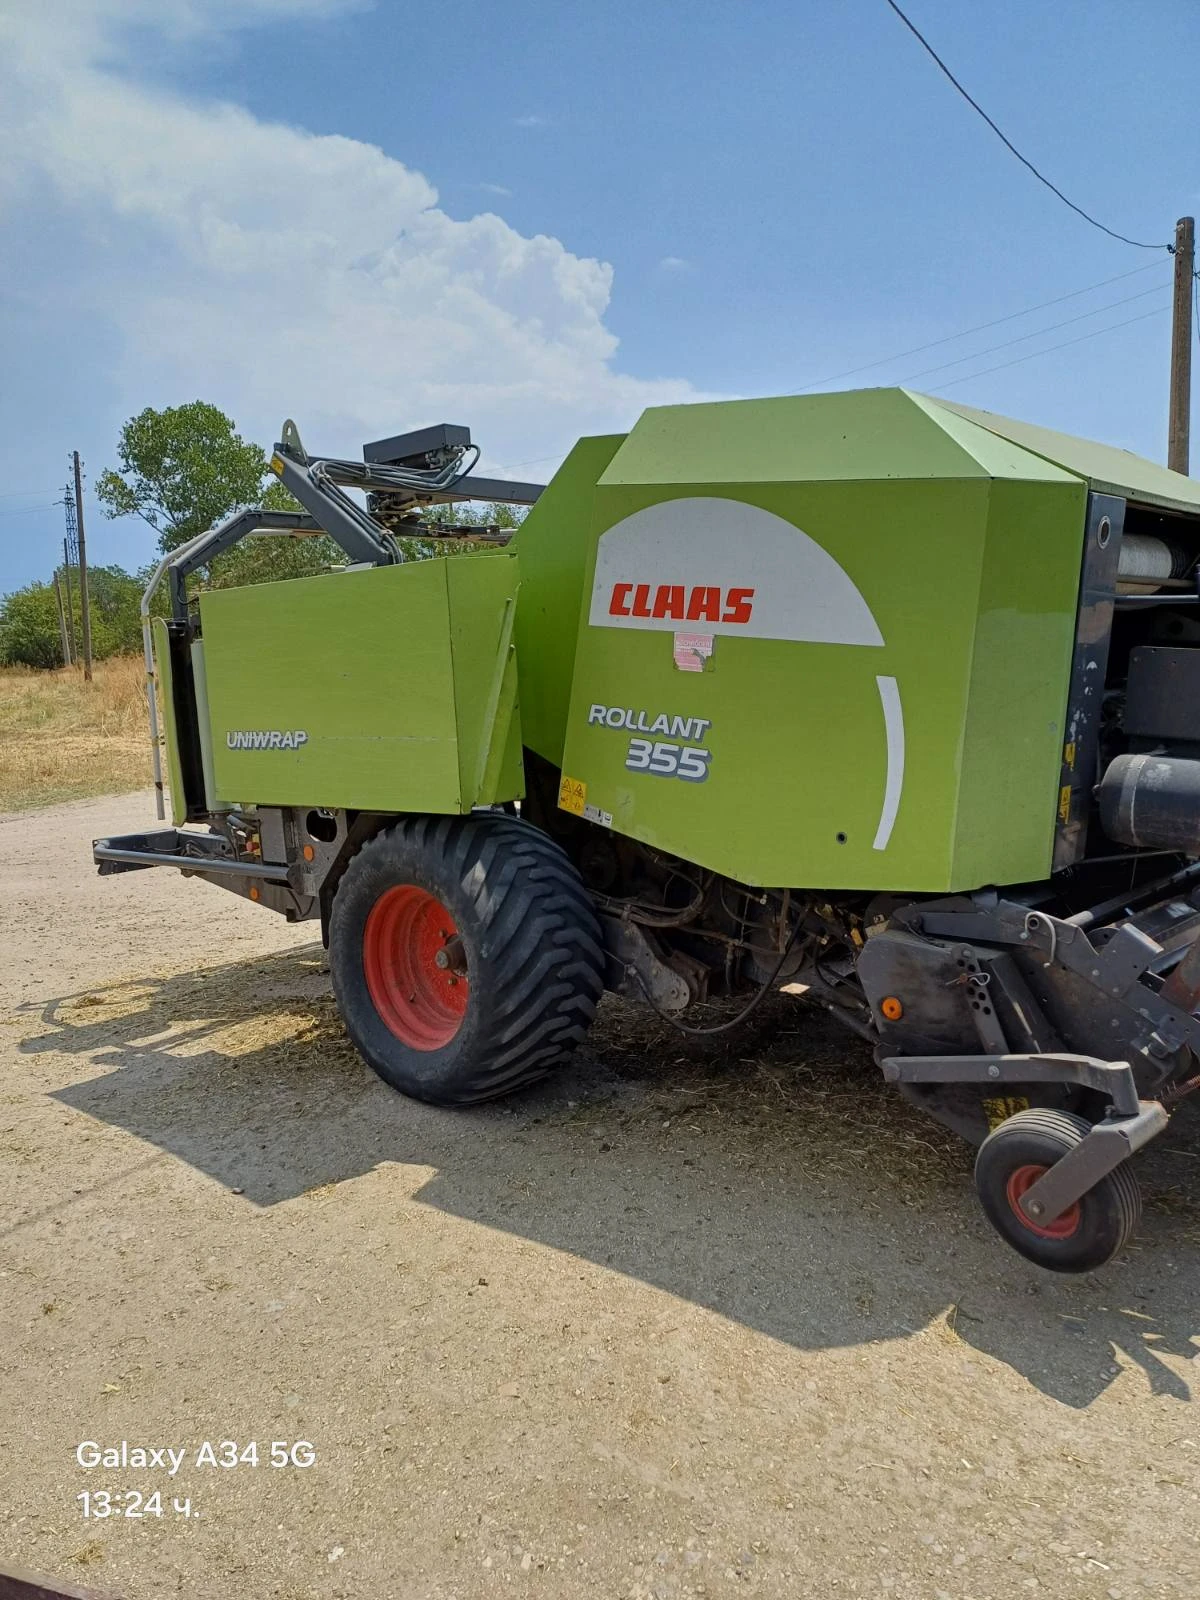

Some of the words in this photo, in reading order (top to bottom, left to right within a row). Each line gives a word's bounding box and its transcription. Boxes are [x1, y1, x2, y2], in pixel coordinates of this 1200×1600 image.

[609, 583, 755, 623] CLAAS
[226, 730, 308, 749] UNIWRAP
[588, 704, 710, 740] ROLLANT
[626, 738, 711, 781] 355
